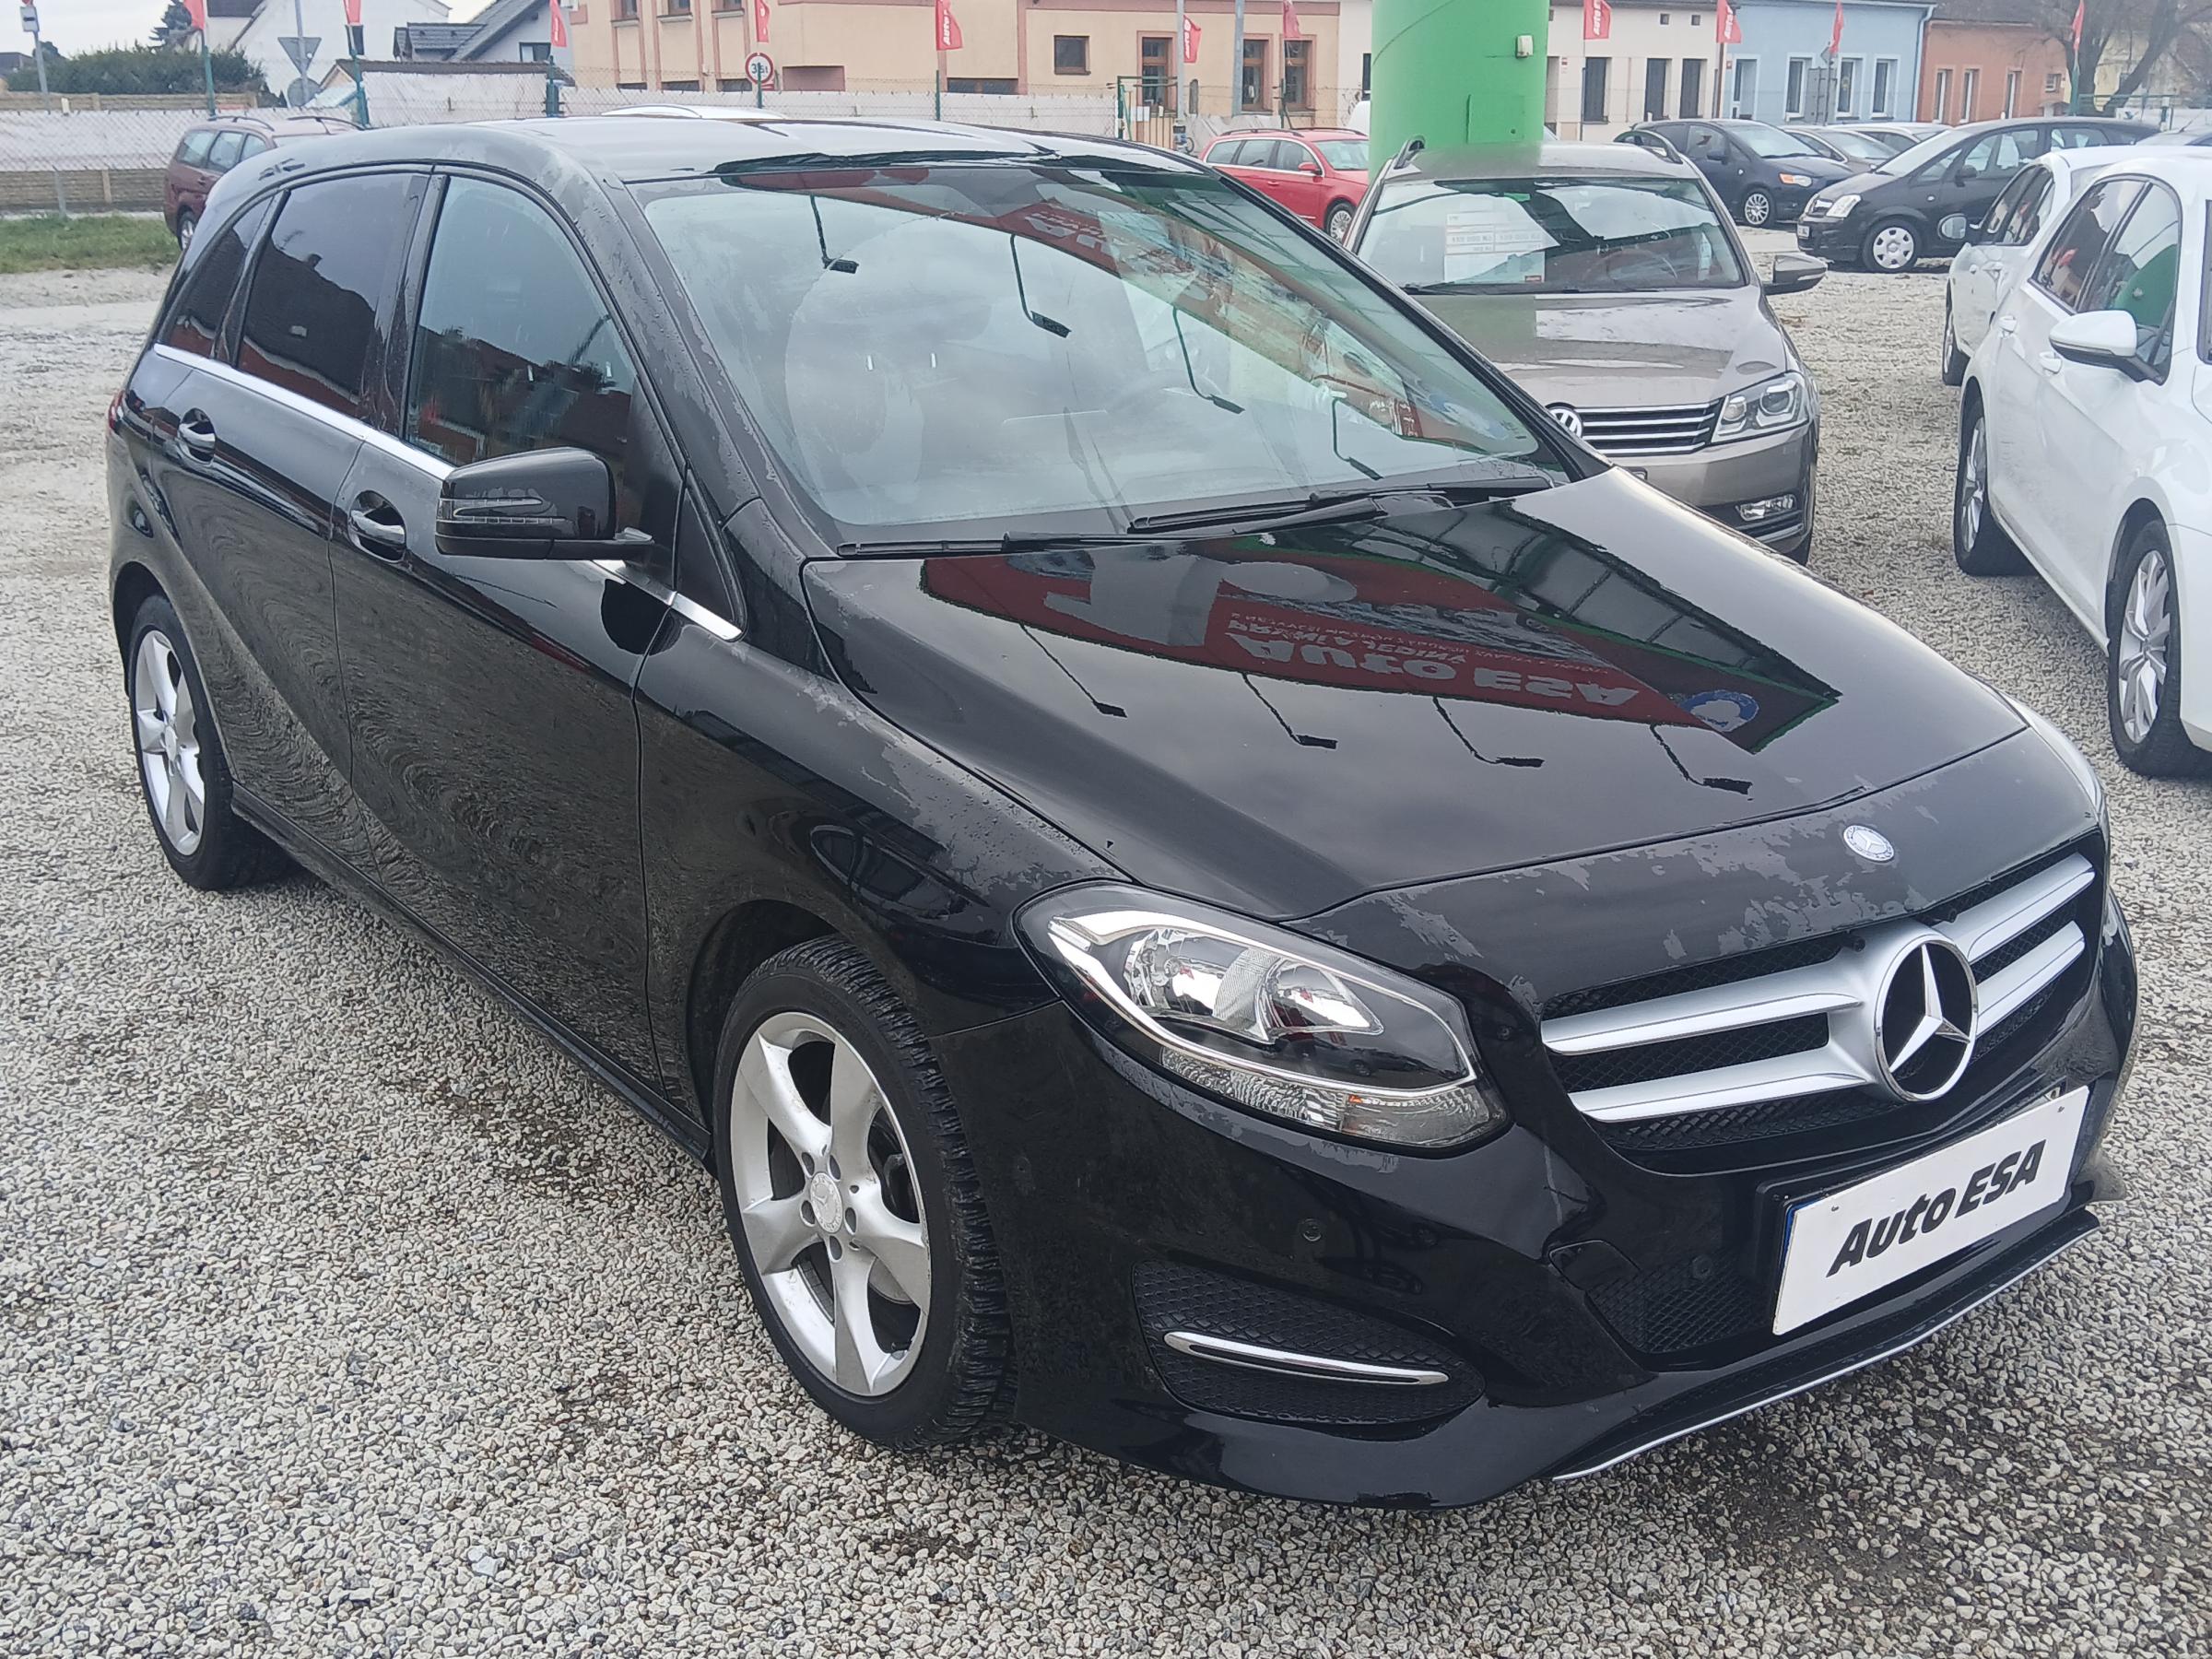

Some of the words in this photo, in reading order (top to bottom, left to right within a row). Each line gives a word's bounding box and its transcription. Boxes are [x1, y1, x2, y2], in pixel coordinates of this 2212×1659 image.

[751, 63, 769, 74] 35t
[1826, 1187, 1957, 1278] Auto
[1954, 1138, 2047, 1219] ESA
